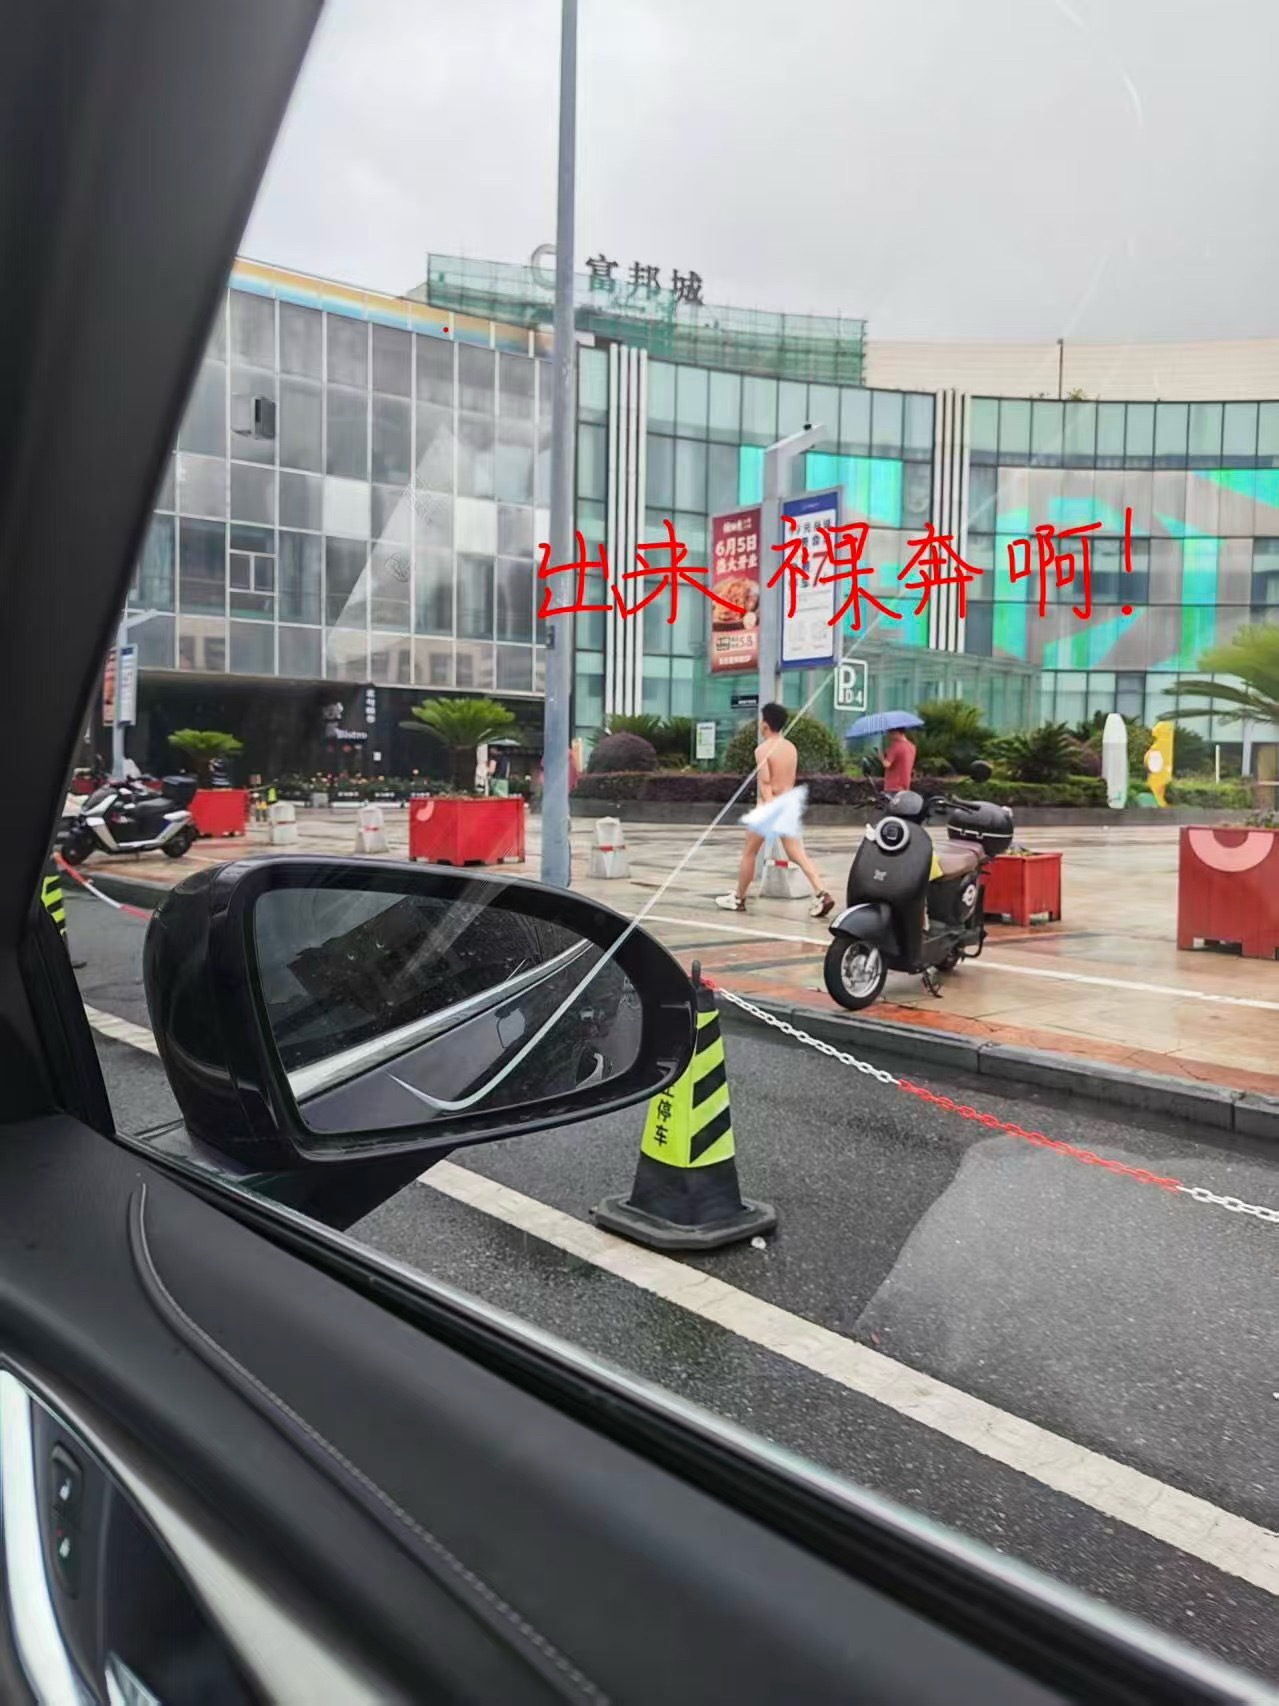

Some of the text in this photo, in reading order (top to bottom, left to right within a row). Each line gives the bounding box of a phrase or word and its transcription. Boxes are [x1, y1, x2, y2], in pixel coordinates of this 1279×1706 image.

[585, 254, 705, 306] 富邦城
[715, 534, 758, 556] 6月5日
[716, 554, 758, 575] 盛大开业
[838, 665, 857, 704] P
